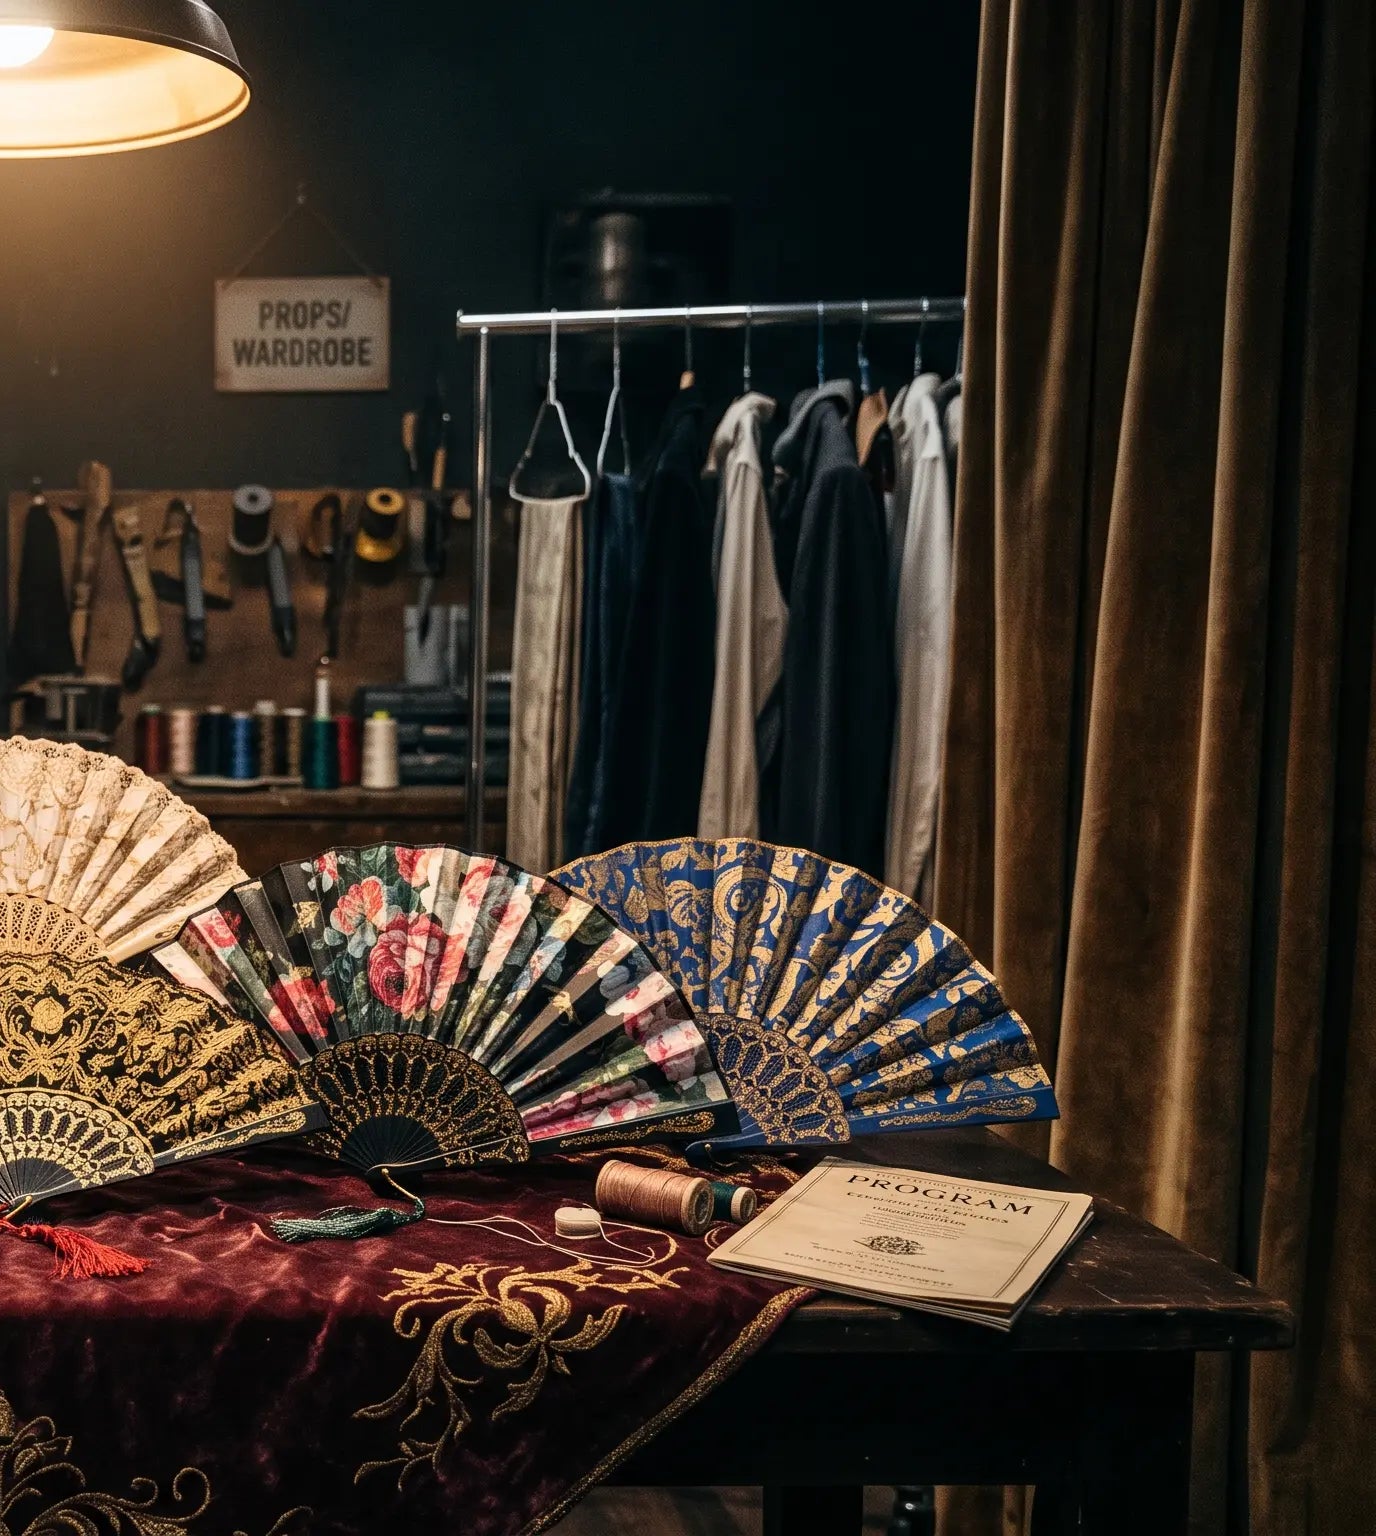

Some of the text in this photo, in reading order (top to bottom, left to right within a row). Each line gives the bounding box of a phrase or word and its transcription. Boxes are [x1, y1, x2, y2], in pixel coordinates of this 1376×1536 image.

[258, 298, 352, 331] PROPS/
[233, 336, 373, 367] WARDROBE
[847, 1174, 1035, 1216] PROGRAM
